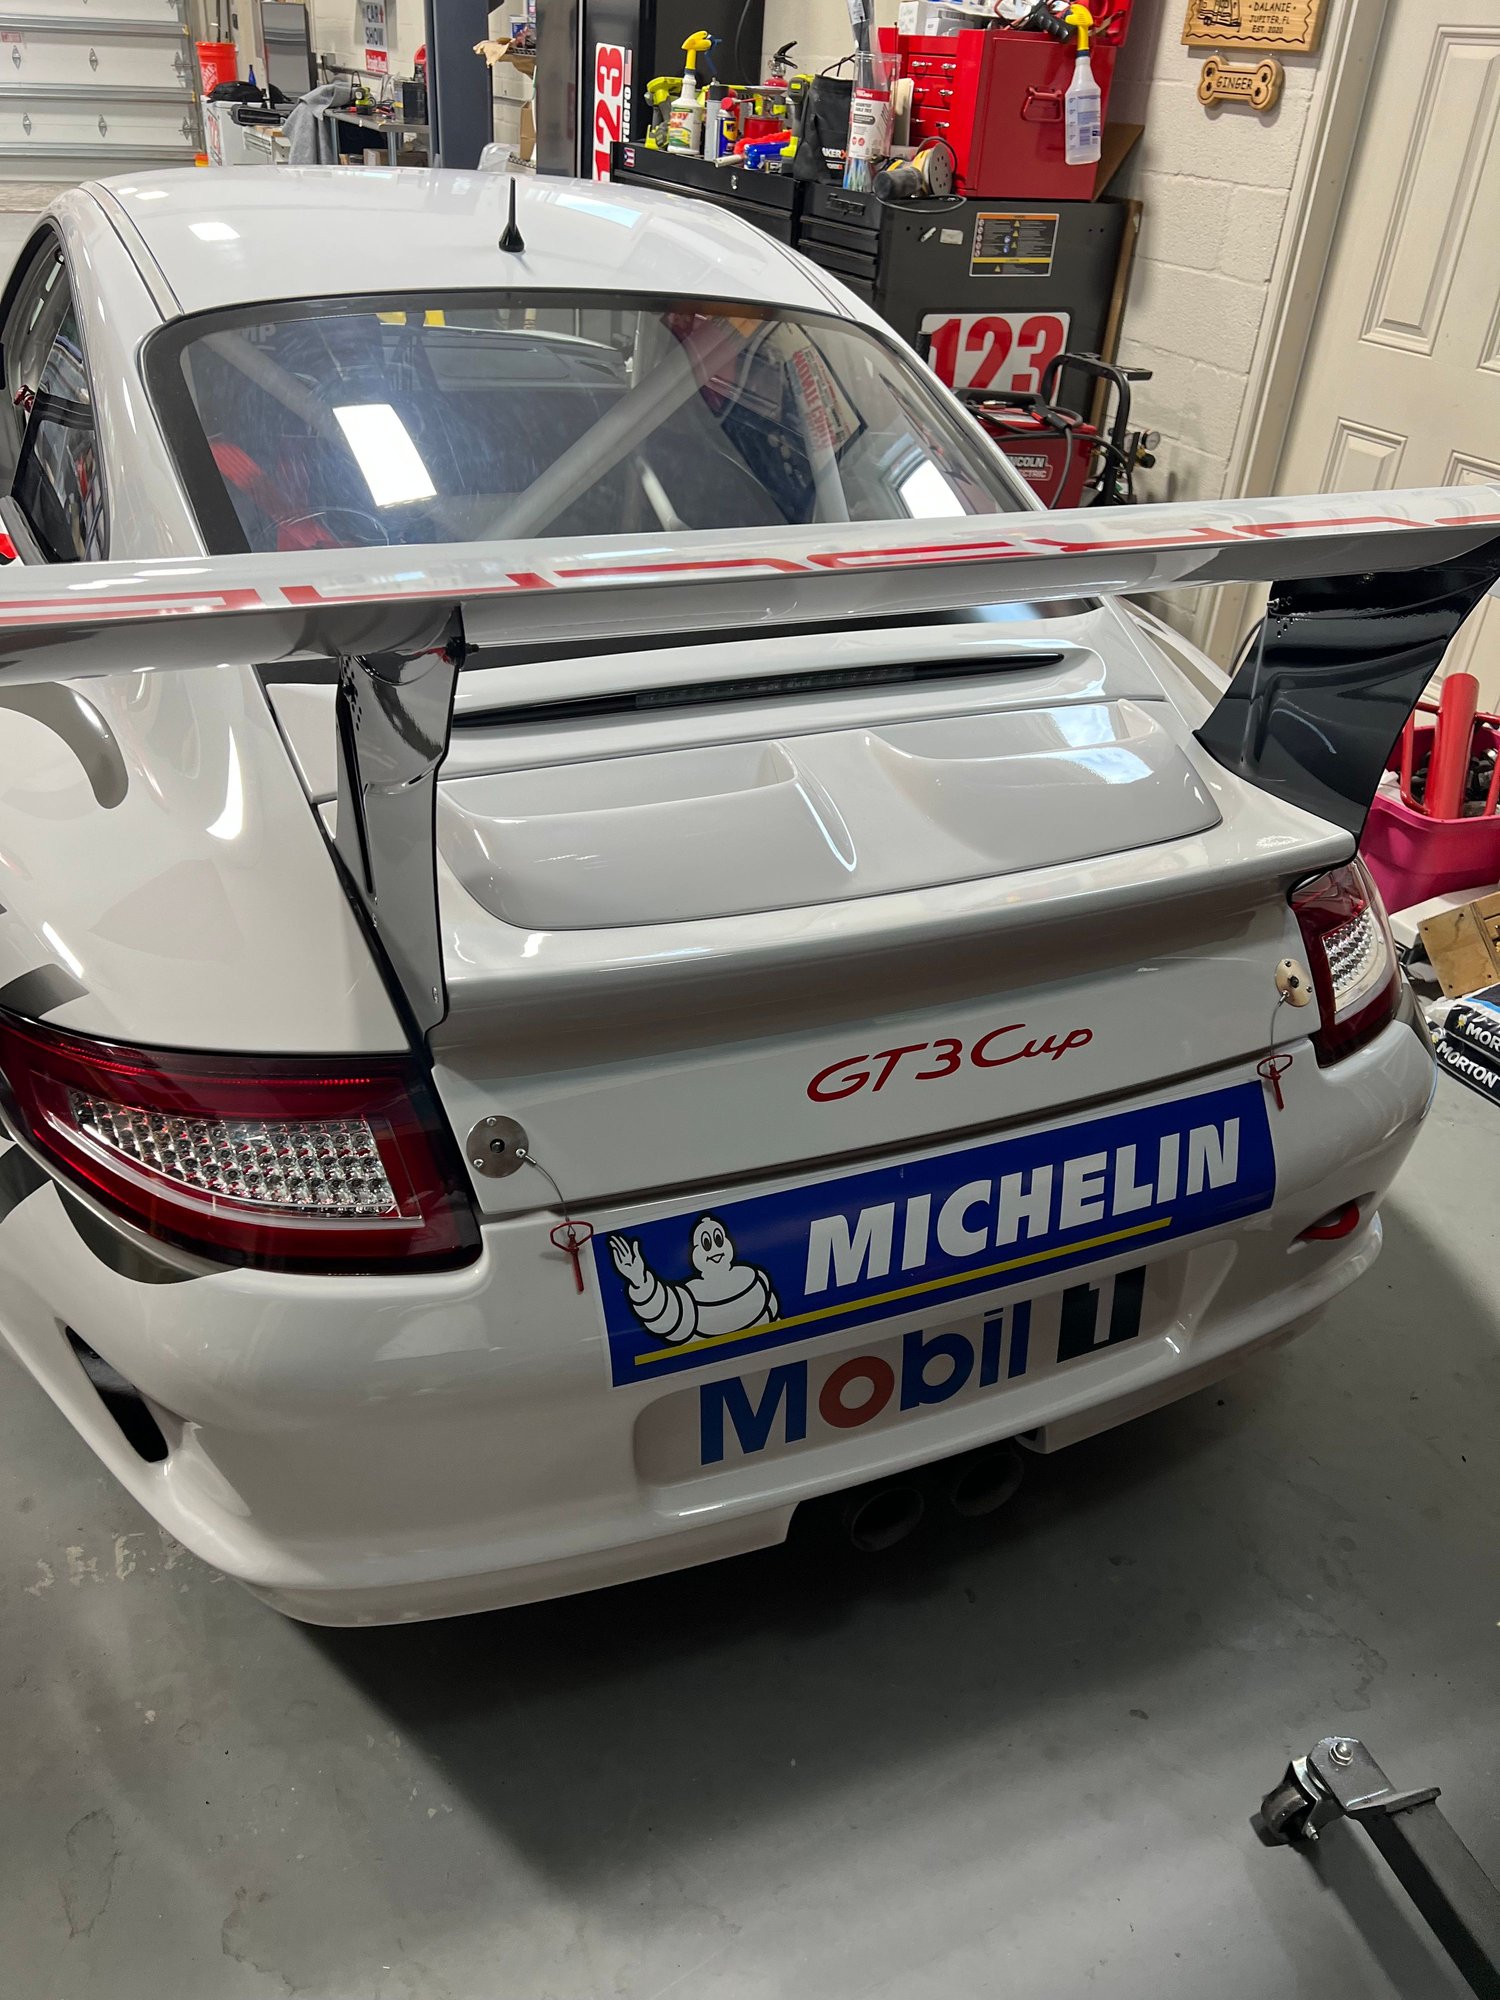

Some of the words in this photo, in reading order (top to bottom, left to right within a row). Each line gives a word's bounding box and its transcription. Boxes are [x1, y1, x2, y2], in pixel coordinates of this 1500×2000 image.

[1253, 2, 1291, 13] DALANIE
[1216, 77, 1253, 90] GINGER
[930, 315, 1064, 399] 123
[1465, 1022, 1500, 1053] MOR
[1436, 1040, 1500, 1088] MORTON
[802, 1117, 1240, 1296] MICHELIN
[699, 1300, 1032, 1467] Mobil
